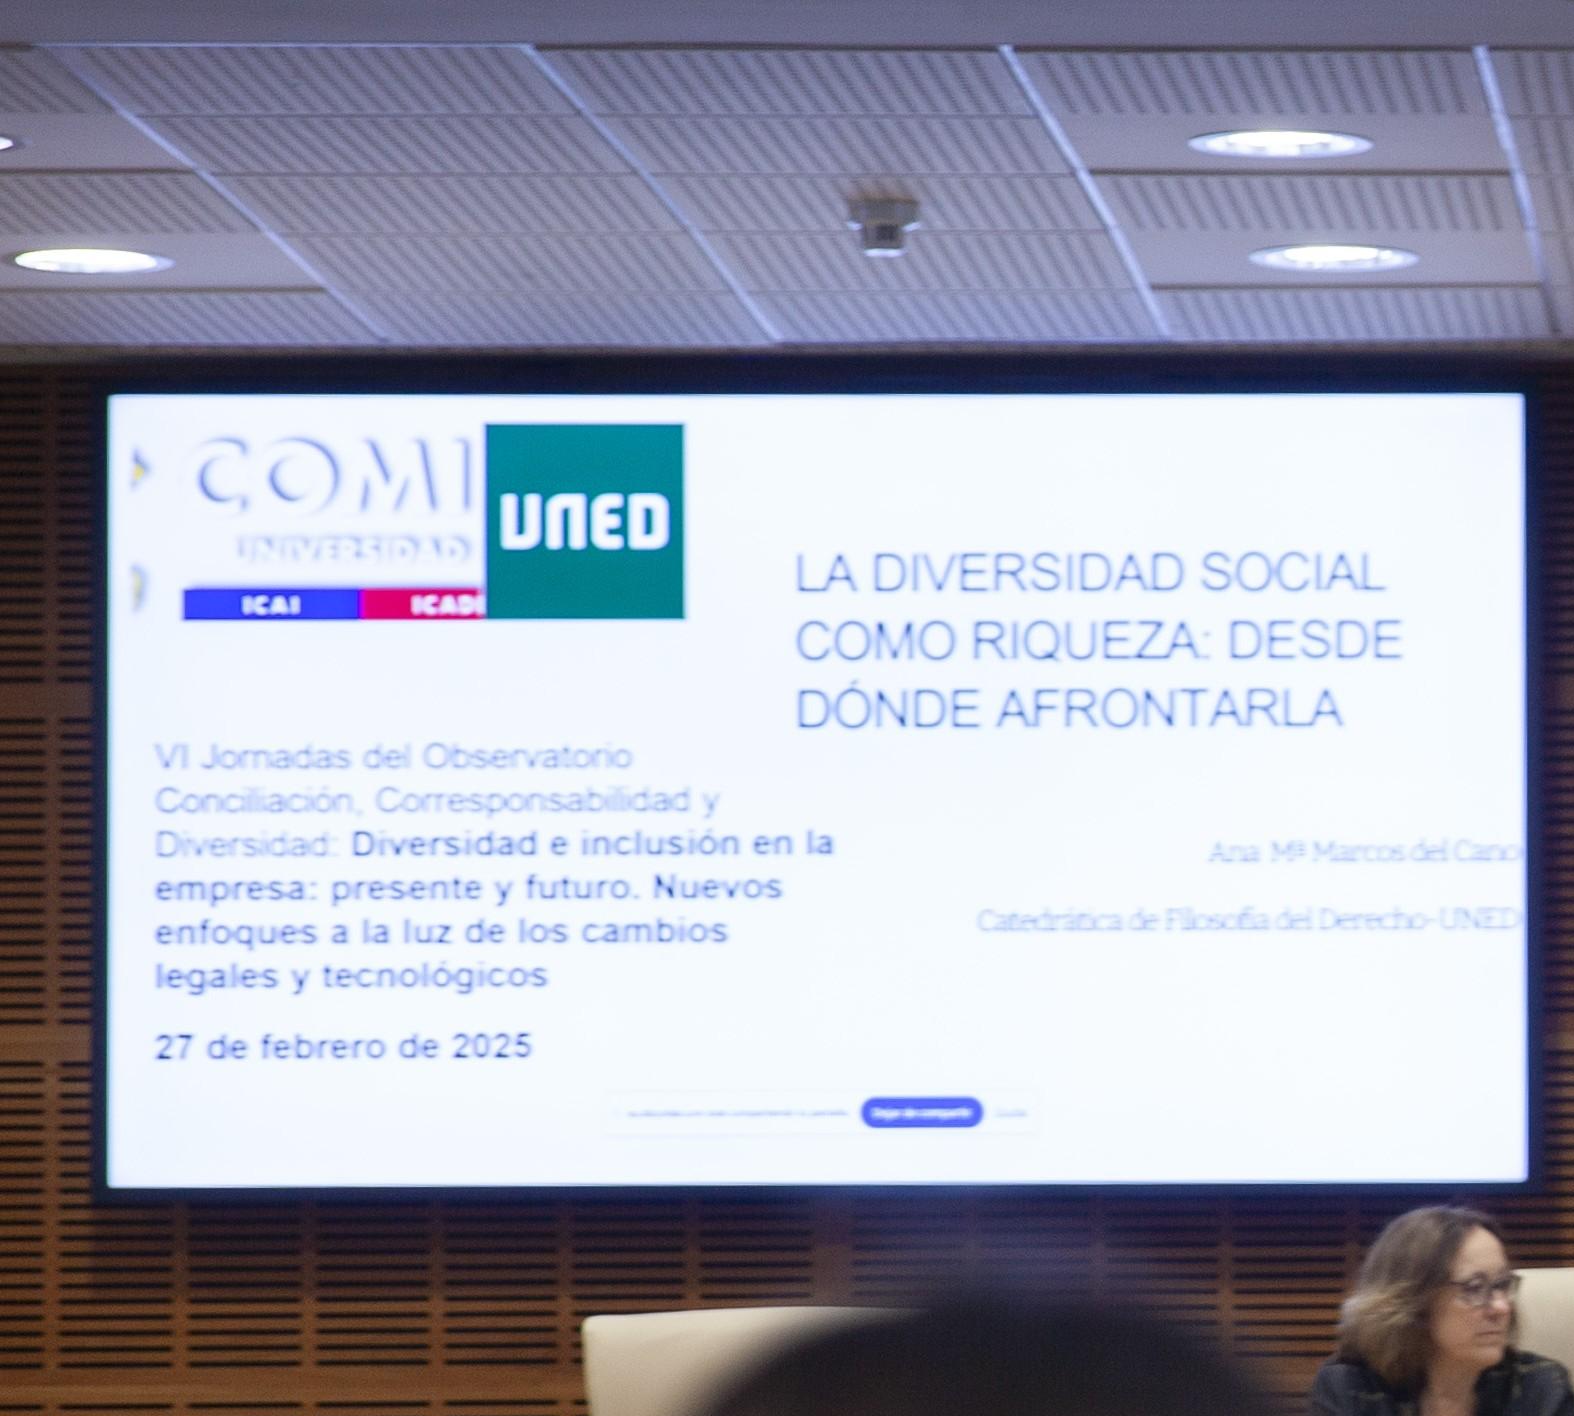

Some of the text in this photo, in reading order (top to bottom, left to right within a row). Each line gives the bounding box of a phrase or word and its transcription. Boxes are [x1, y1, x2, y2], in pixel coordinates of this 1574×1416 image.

[499, 493, 671, 550] UNED
[797, 550, 1387, 593] LA DIVERSIDAD SOCIAL
[241, 594, 300, 616] ICAI
[795, 618, 1402, 663] COMO RIQUEZA: DESDE
[797, 678, 1344, 730] DÓNDE AFRONTARLA
[154, 741, 634, 770] VI Jornadas del Observatorio
[154, 785, 720, 819] Conciliación, Corresponsabilidad y
[155, 829, 834, 859] Diversidad: Diversidad e inclusión en la
[1208, 841, 1261, 863] Ana
[1311, 840, 1406, 863] Marcos
[1409, 839, 1449, 863] del
[154, 874, 783, 907] empresa: presente y futuro. Nuevos
[154, 918, 729, 951] enfoques a la luz de los cambios
[1129, 908, 1160, 932] de
[1164, 905, 1272, 931] Filosofía
[1274, 907, 1314, 931] del
[156, 961, 549, 996] legales y tecnológicos
[155, 1032, 532, 1060] 27 de febrero de 2025
